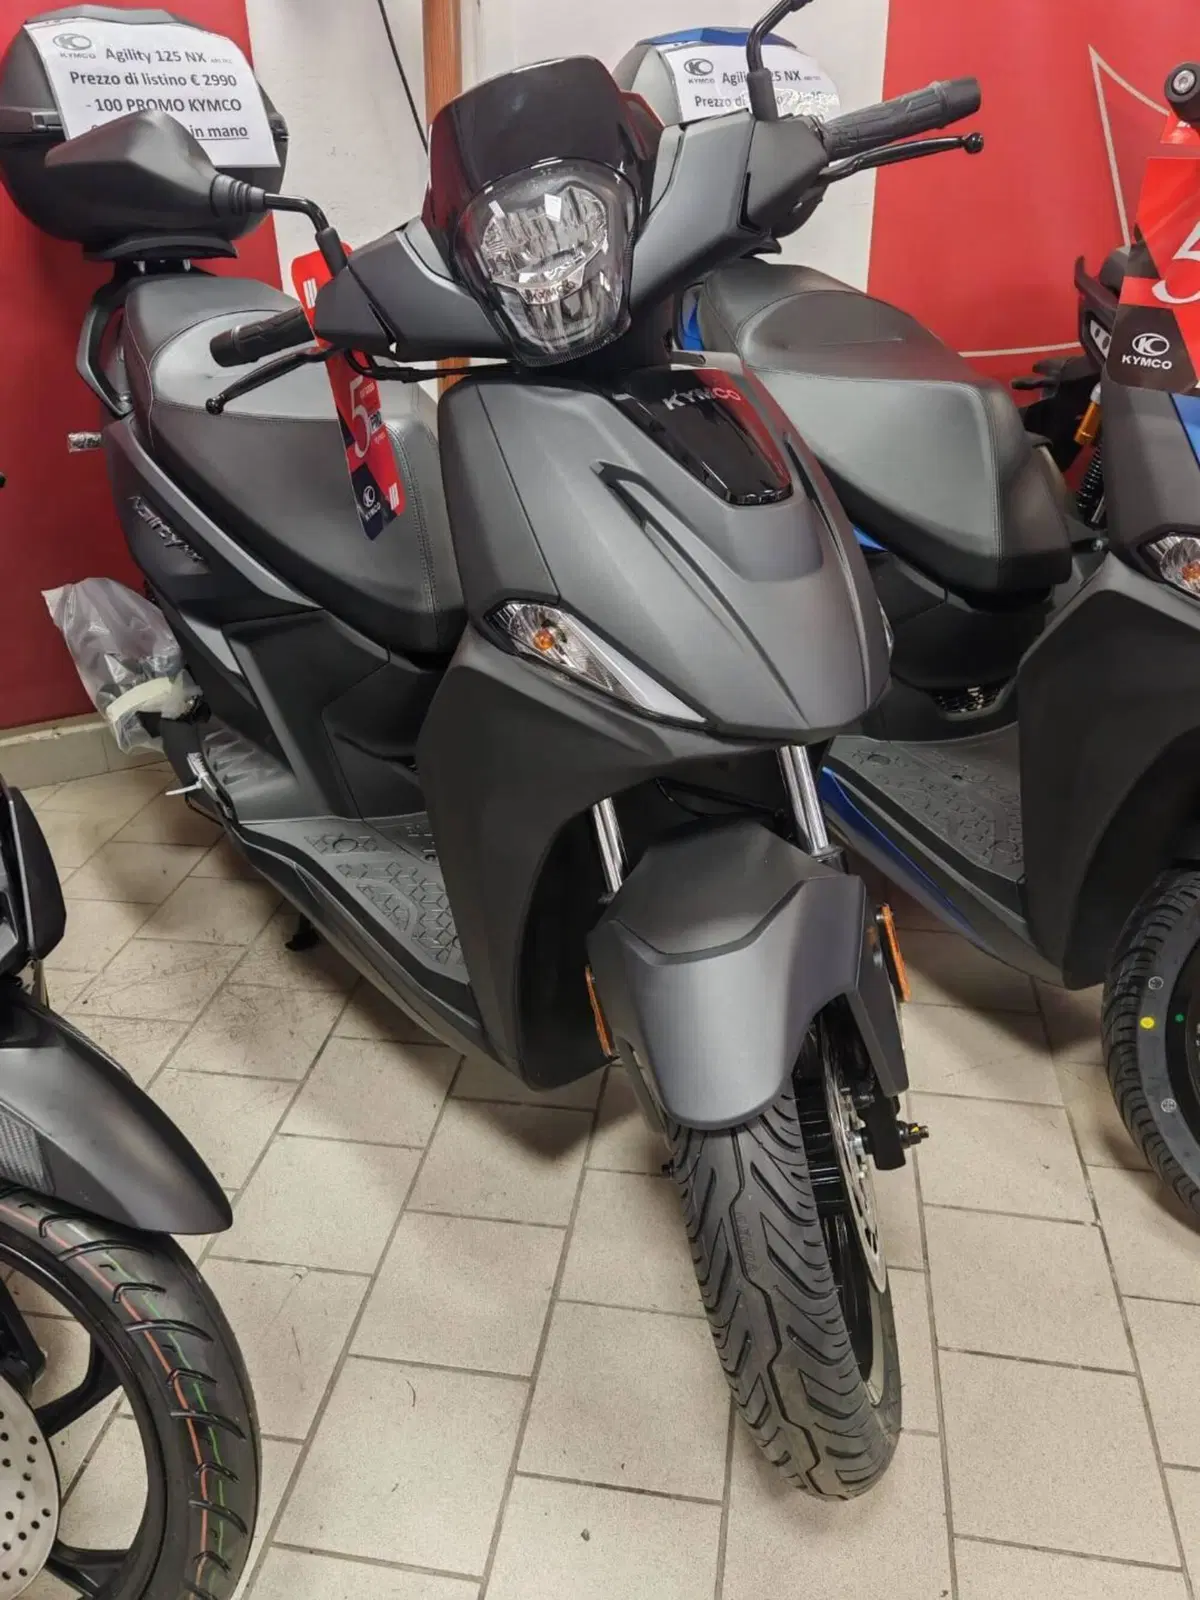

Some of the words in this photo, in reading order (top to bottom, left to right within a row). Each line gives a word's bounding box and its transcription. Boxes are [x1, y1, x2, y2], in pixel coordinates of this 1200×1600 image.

[105, 47, 151, 64] Agility
[156, 50, 182, 62] 125
[185, 51, 207, 63] NX
[69, 71, 121, 85] Prezzo
[124, 72, 139, 85] di
[141, 72, 187, 86] listino
[190, 74, 201, 86] €
[202, 74, 237, 86] 2990
[783, 70, 801, 81] NX
[95, 98, 123, 112] 100
[126, 98, 185, 112] PROMO
[188, 98, 242, 112] KYMCO
[694, 95, 732, 107] Prezzo
[734, 94, 746, 107] di
[189, 124, 204, 137] in
[207, 126, 248, 137] mano
[1121, 354, 1173, 370] KYMCO
[661, 387, 742, 411] KYMCO
[349, 374, 371, 458] 5
